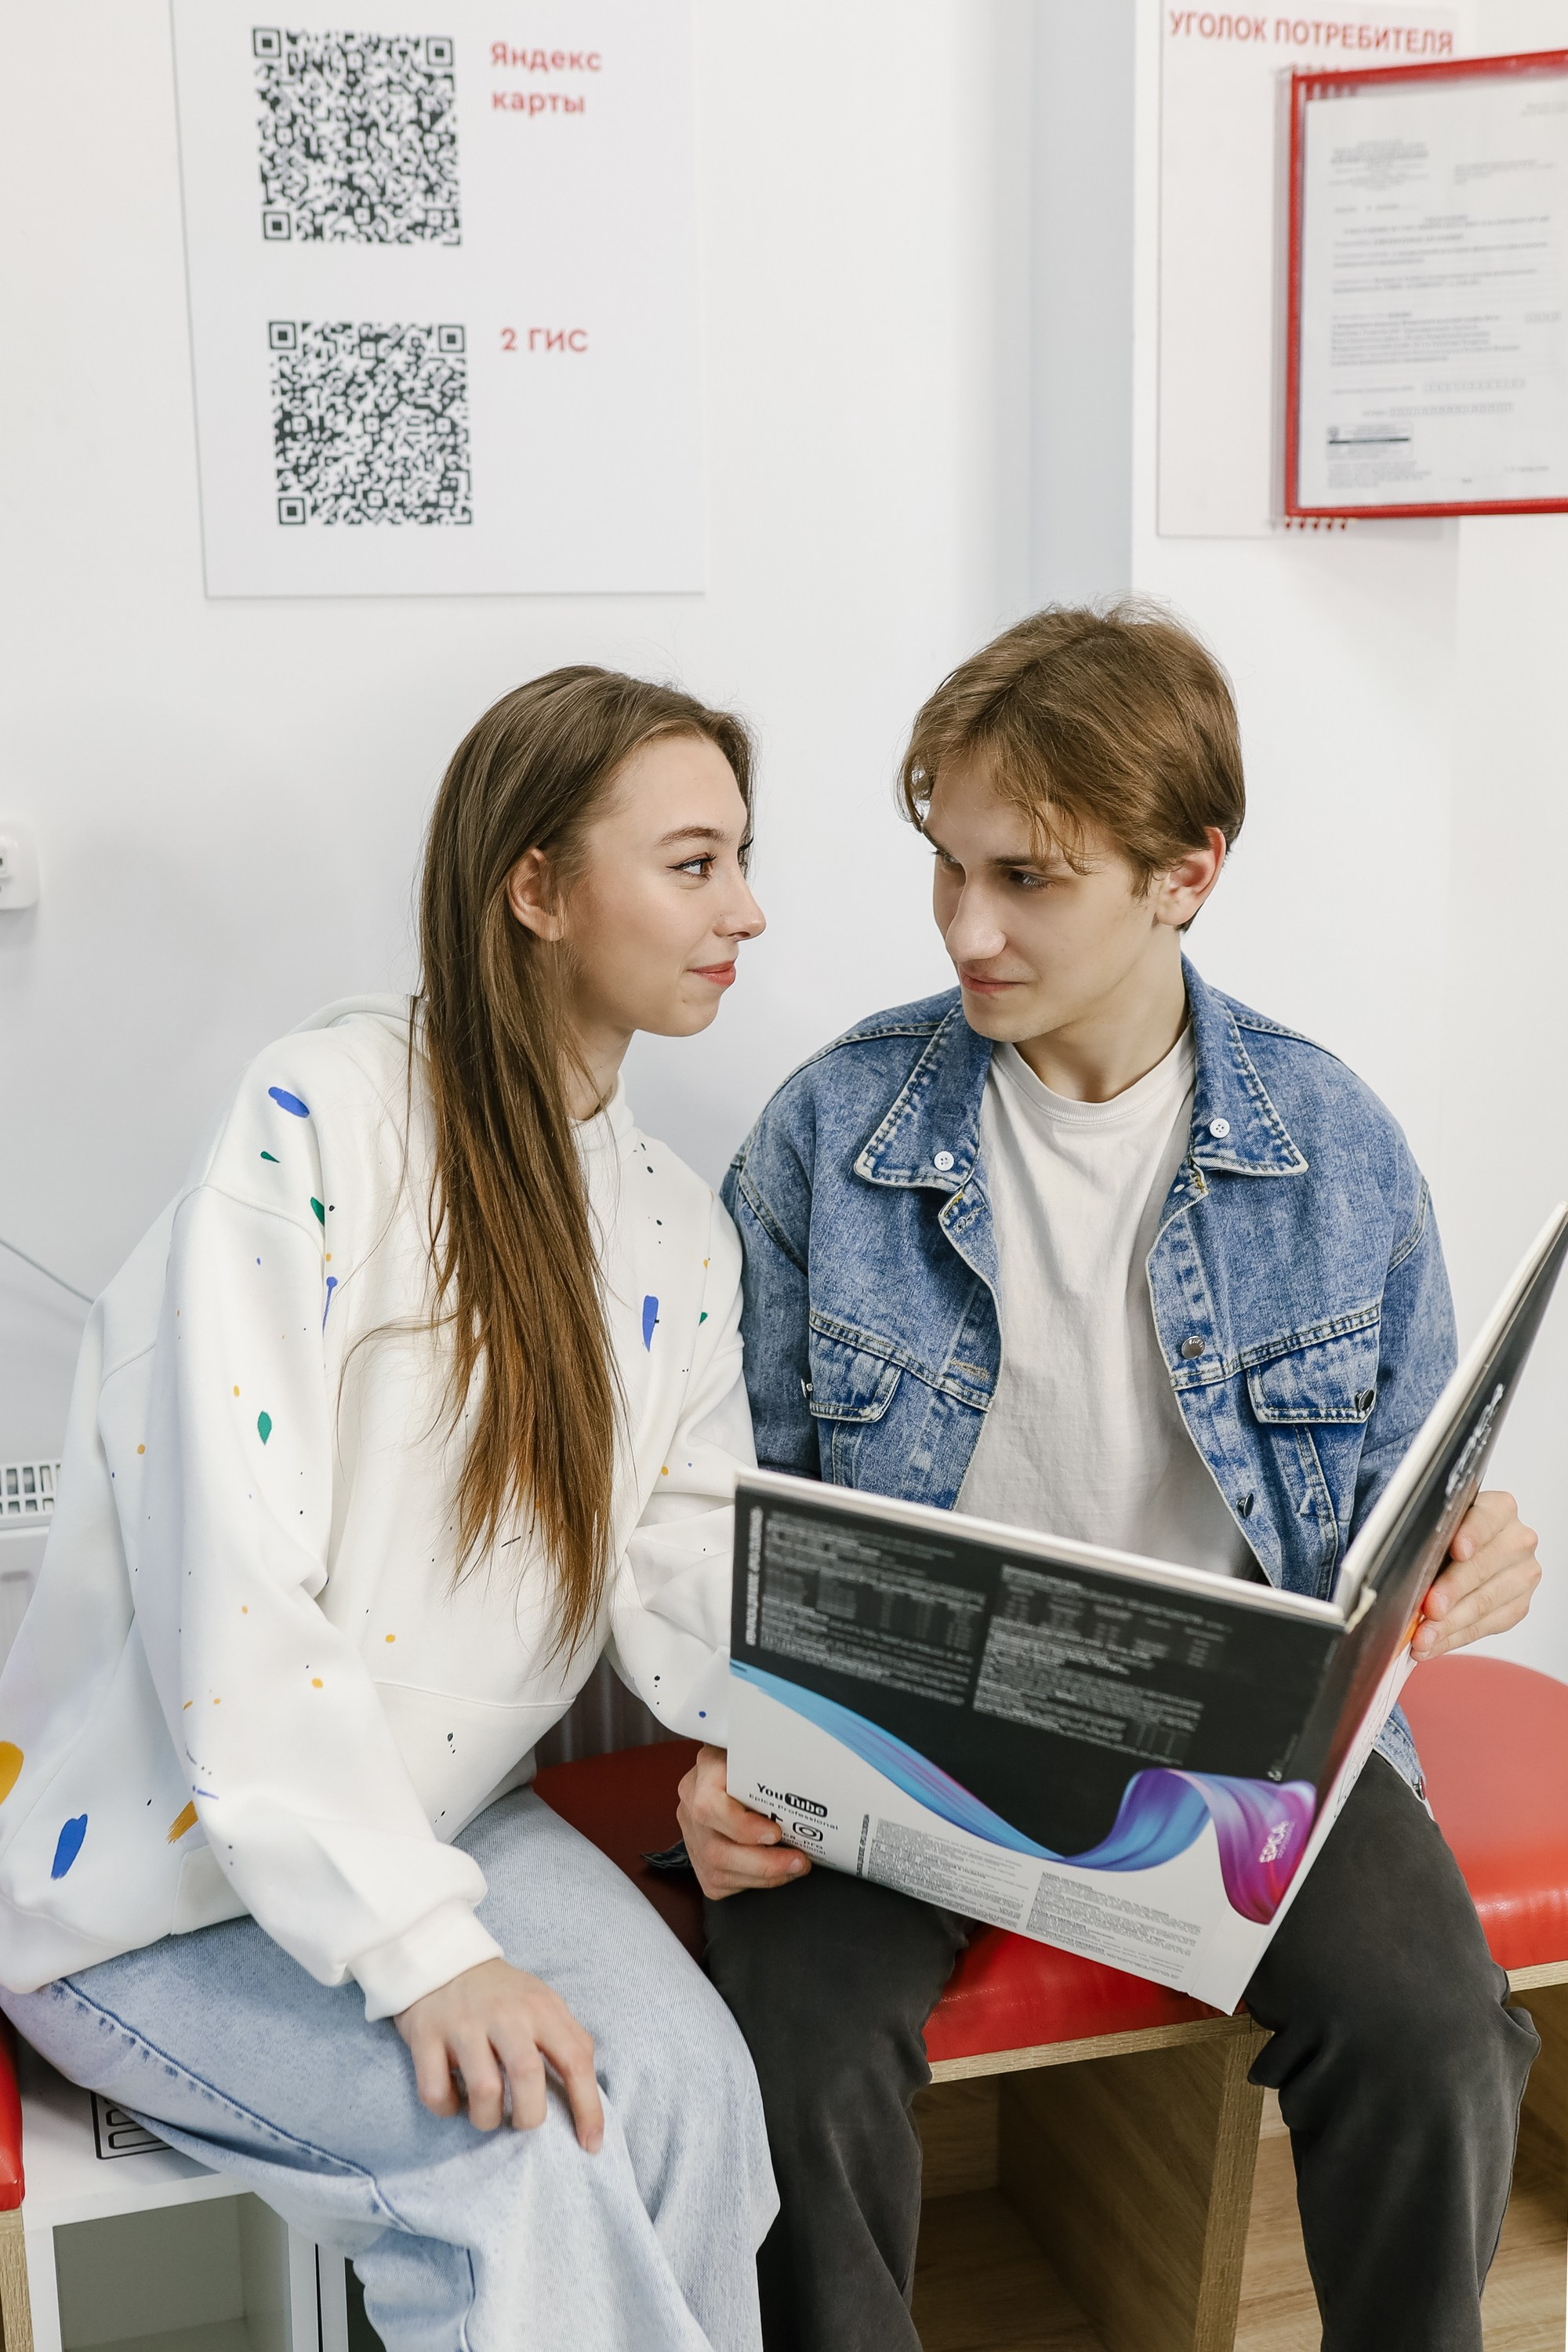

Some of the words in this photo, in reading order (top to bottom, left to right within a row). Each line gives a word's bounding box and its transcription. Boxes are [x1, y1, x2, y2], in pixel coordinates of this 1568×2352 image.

[1170, 10, 1267, 43] УГОЛОК
[1274, 18, 1454, 55] ПОТРЕБИТЕЛЯ
[491, 41, 602, 73] Яндекс
[492, 91, 585, 118] карты
[500, 326, 517, 351] 2
[529, 326, 589, 353] ГИС
[757, 1782, 828, 1818] YouTube
